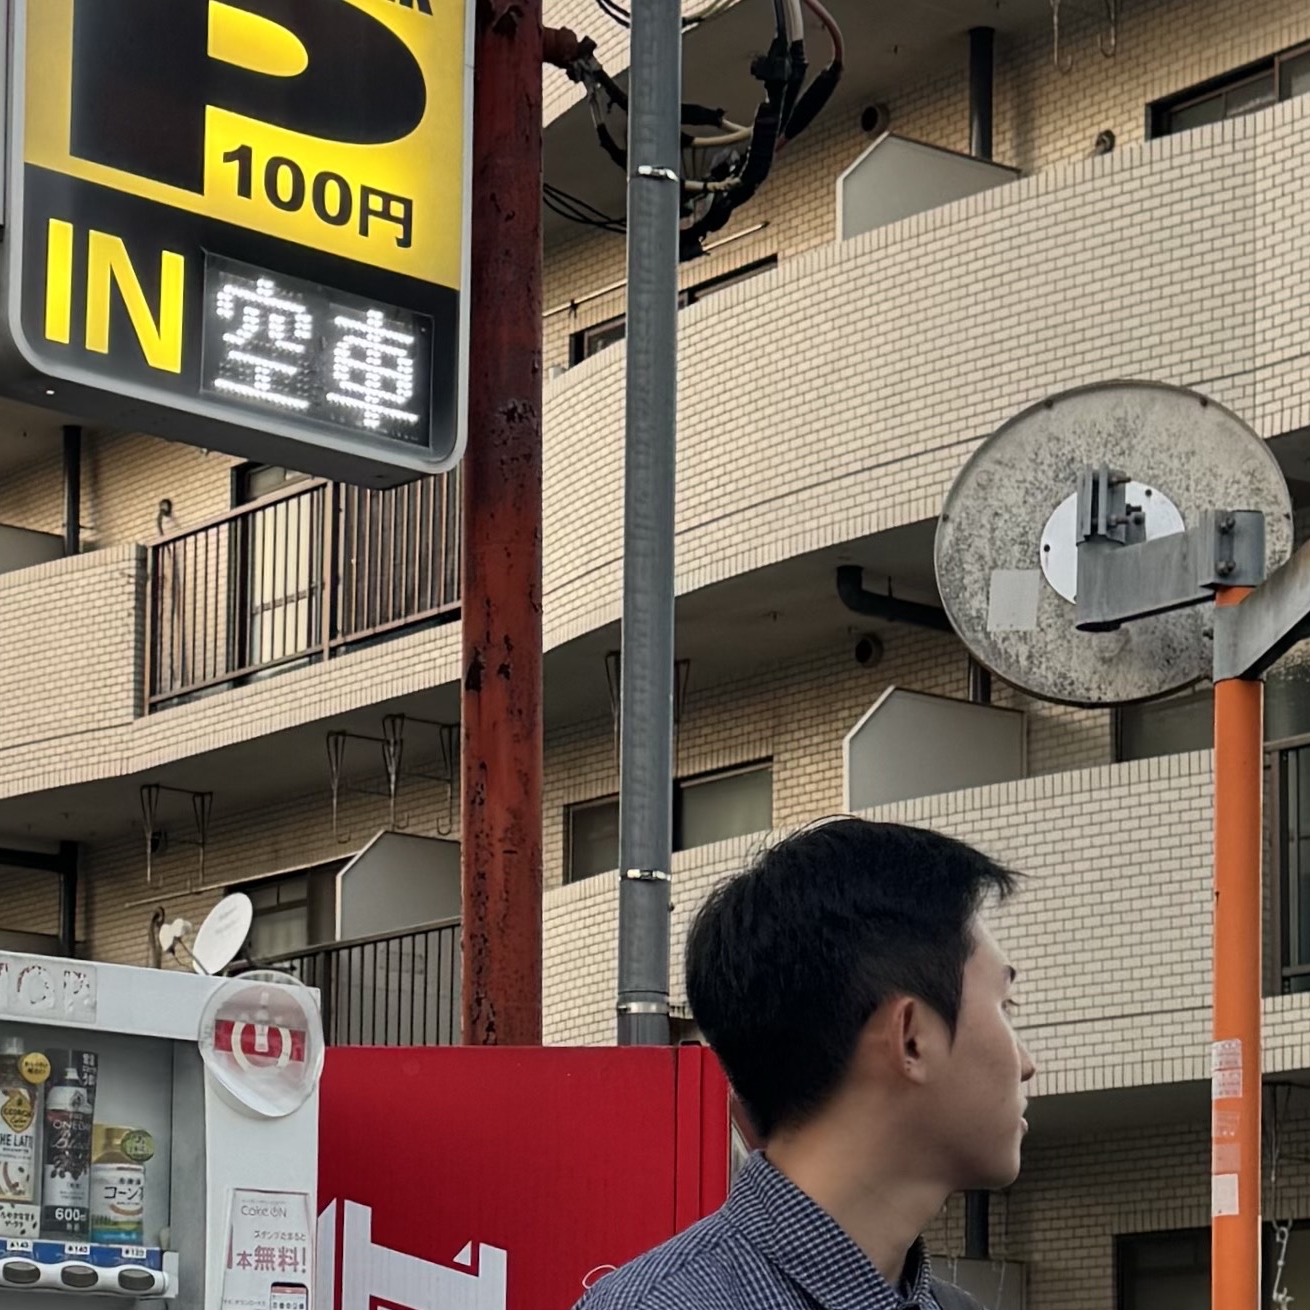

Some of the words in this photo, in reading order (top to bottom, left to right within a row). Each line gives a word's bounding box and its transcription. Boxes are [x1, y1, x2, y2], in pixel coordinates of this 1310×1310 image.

[222, 143, 415, 250] 100円
[43, 217, 186, 375] IN
[213, 277, 419, 430] 空車
[241, 1205, 269, 1217] Coke
